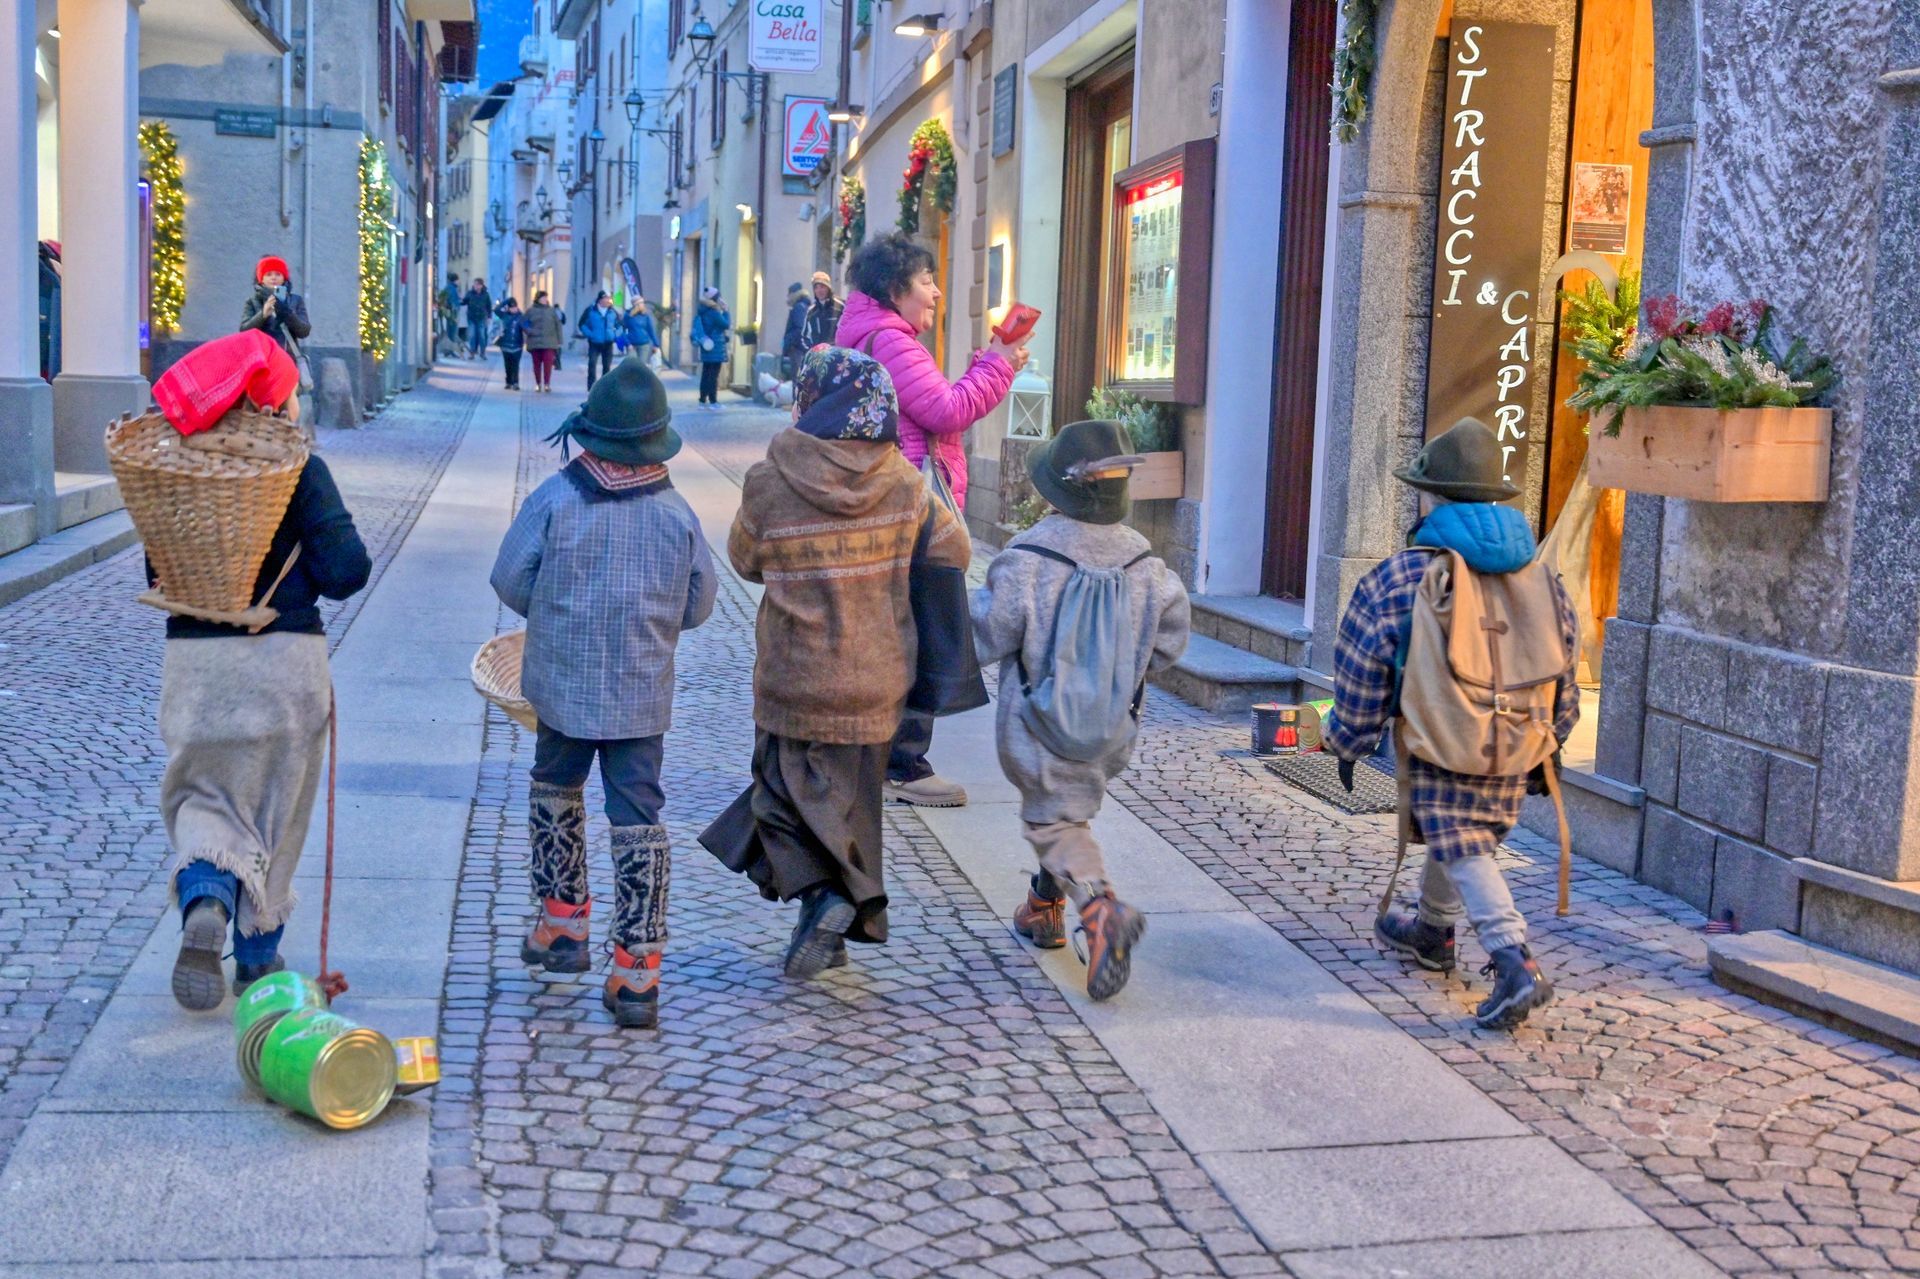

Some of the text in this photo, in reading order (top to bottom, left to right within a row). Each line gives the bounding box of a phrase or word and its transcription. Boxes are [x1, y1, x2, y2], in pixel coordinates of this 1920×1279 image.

[757, 0, 805, 18] Casa
[768, 20, 817, 42] Bella
[1442, 26, 1530, 505] STRACCI & CAPRI
